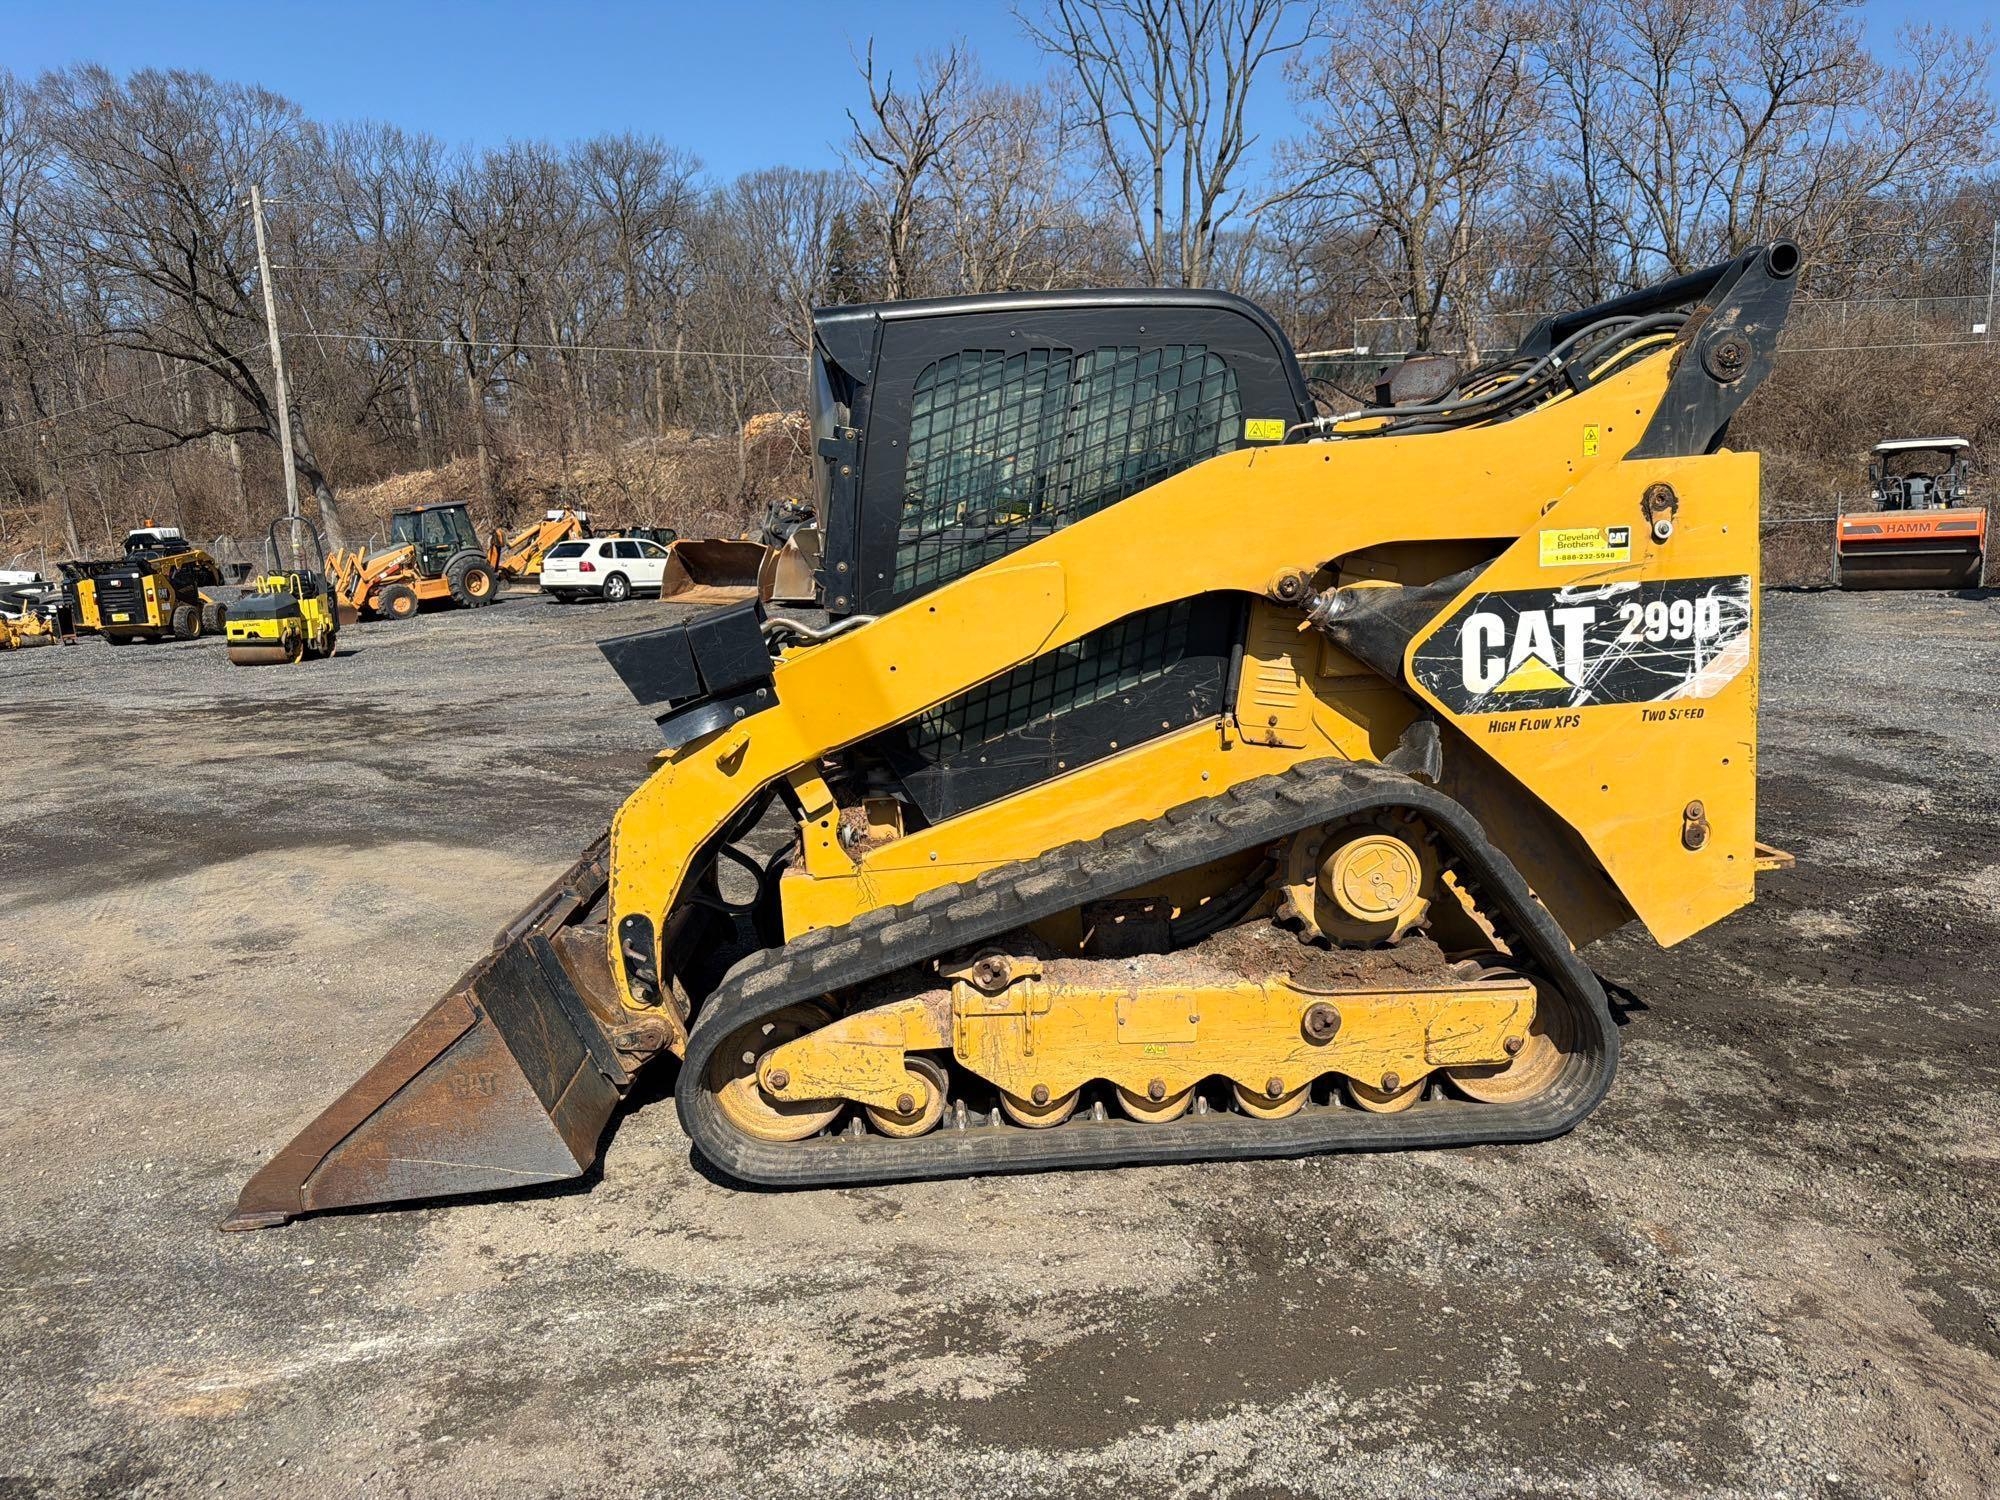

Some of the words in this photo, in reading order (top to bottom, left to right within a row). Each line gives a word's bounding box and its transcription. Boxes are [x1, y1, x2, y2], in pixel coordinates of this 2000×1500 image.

[1886, 522, 1931, 533] HAMM
[1557, 533, 1600, 542] Cleveland
[1609, 532, 1628, 544] CAT
[1557, 541, 1594, 549] Brothers
[1461, 606, 1596, 694] CAT
[1619, 598, 1720, 643] 299D
[1641, 709, 1666, 722] TWO
[1488, 720, 1516, 733] HIGH
[1519, 718, 1552, 730] FLOW
[1553, 715, 1581, 729] XPS
